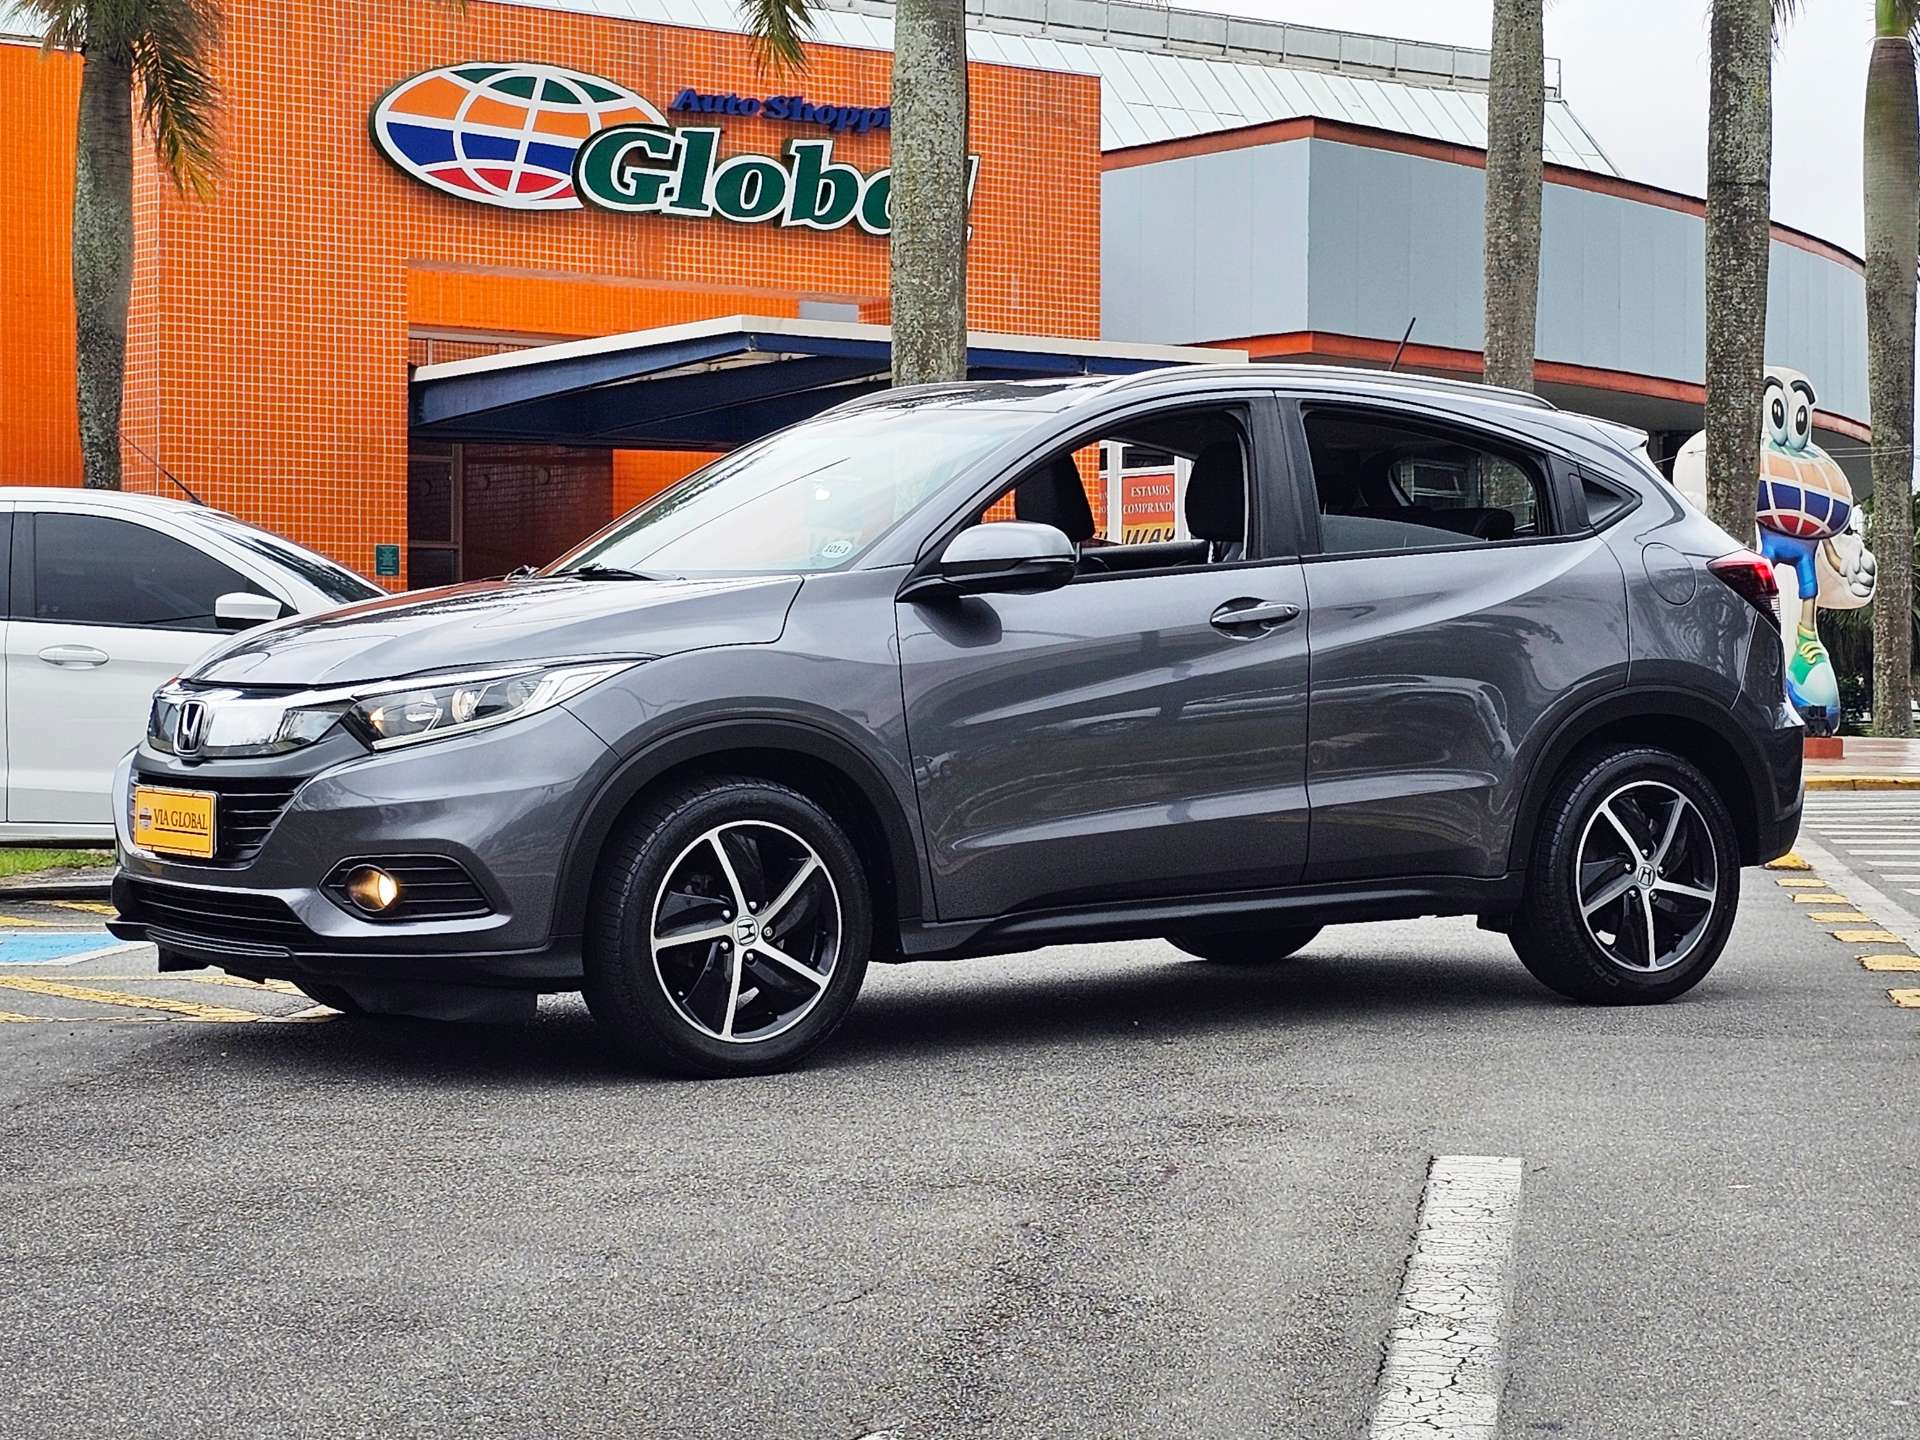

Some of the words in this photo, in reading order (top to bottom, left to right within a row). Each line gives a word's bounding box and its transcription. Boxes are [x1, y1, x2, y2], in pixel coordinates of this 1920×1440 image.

[669, 88, 761, 115] Auto
[761, 95, 891, 133] Shoppi
[574, 125, 980, 241] Glob
[1131, 484, 1171, 498] ESTAMOS
[153, 808, 169, 826] VIA
[170, 810, 209, 830] GLOBAL
